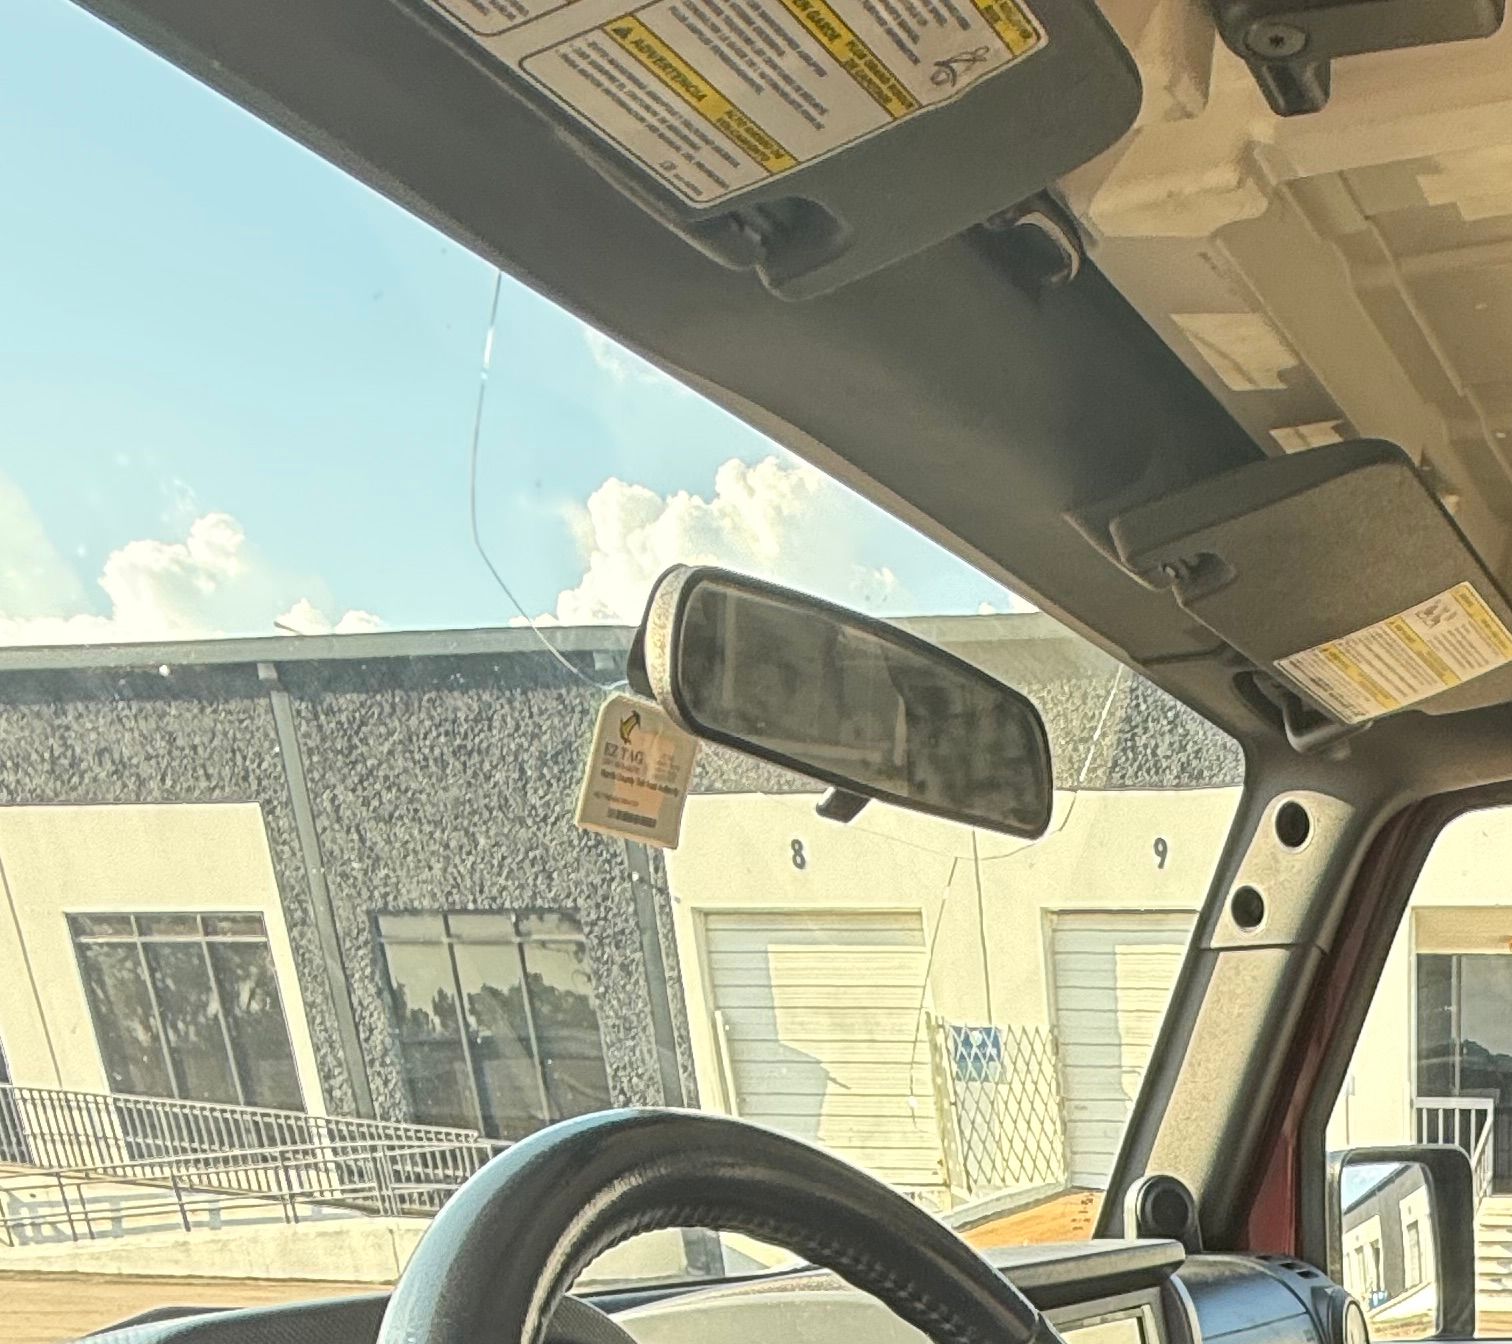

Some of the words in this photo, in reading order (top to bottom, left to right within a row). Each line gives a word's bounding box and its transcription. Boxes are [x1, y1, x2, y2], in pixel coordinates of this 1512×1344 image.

[630, 38, 708, 102] ADVERTENCIA
[604, 741, 619, 757] EZ
[621, 746, 644, 765] TAG
[791, 838, 806, 870] 8
[1153, 837, 1168, 869] 9
